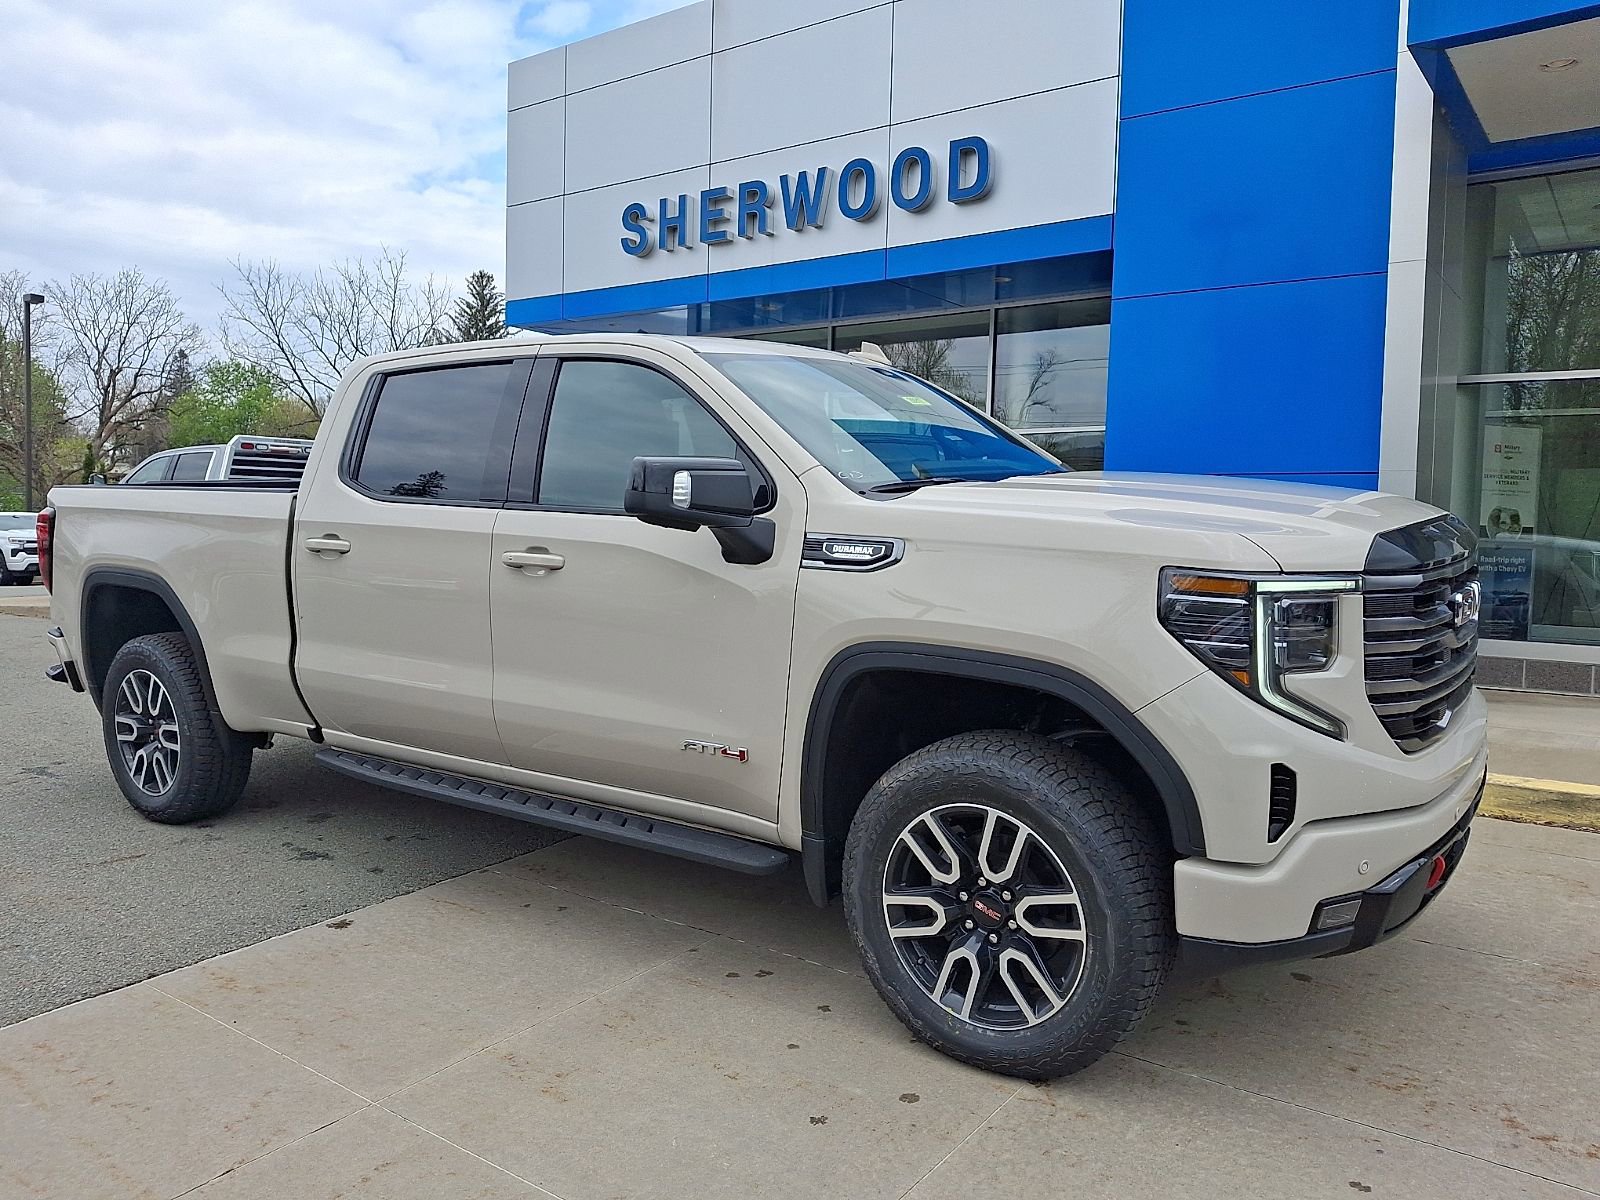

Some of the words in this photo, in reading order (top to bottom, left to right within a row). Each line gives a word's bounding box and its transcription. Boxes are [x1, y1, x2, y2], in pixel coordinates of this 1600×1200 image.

[620, 135, 994, 258] SHERWOOD
[832, 545, 874, 555] DURAMAX
[1480, 555, 1510, 564] Road-trip
[1511, 556, 1526, 565] right
[1498, 565, 1518, 573] Chevy
[1518, 565, 1527, 573] EV
[680, 739, 749, 763] AT4
[975, 900, 1002, 921] GMC
